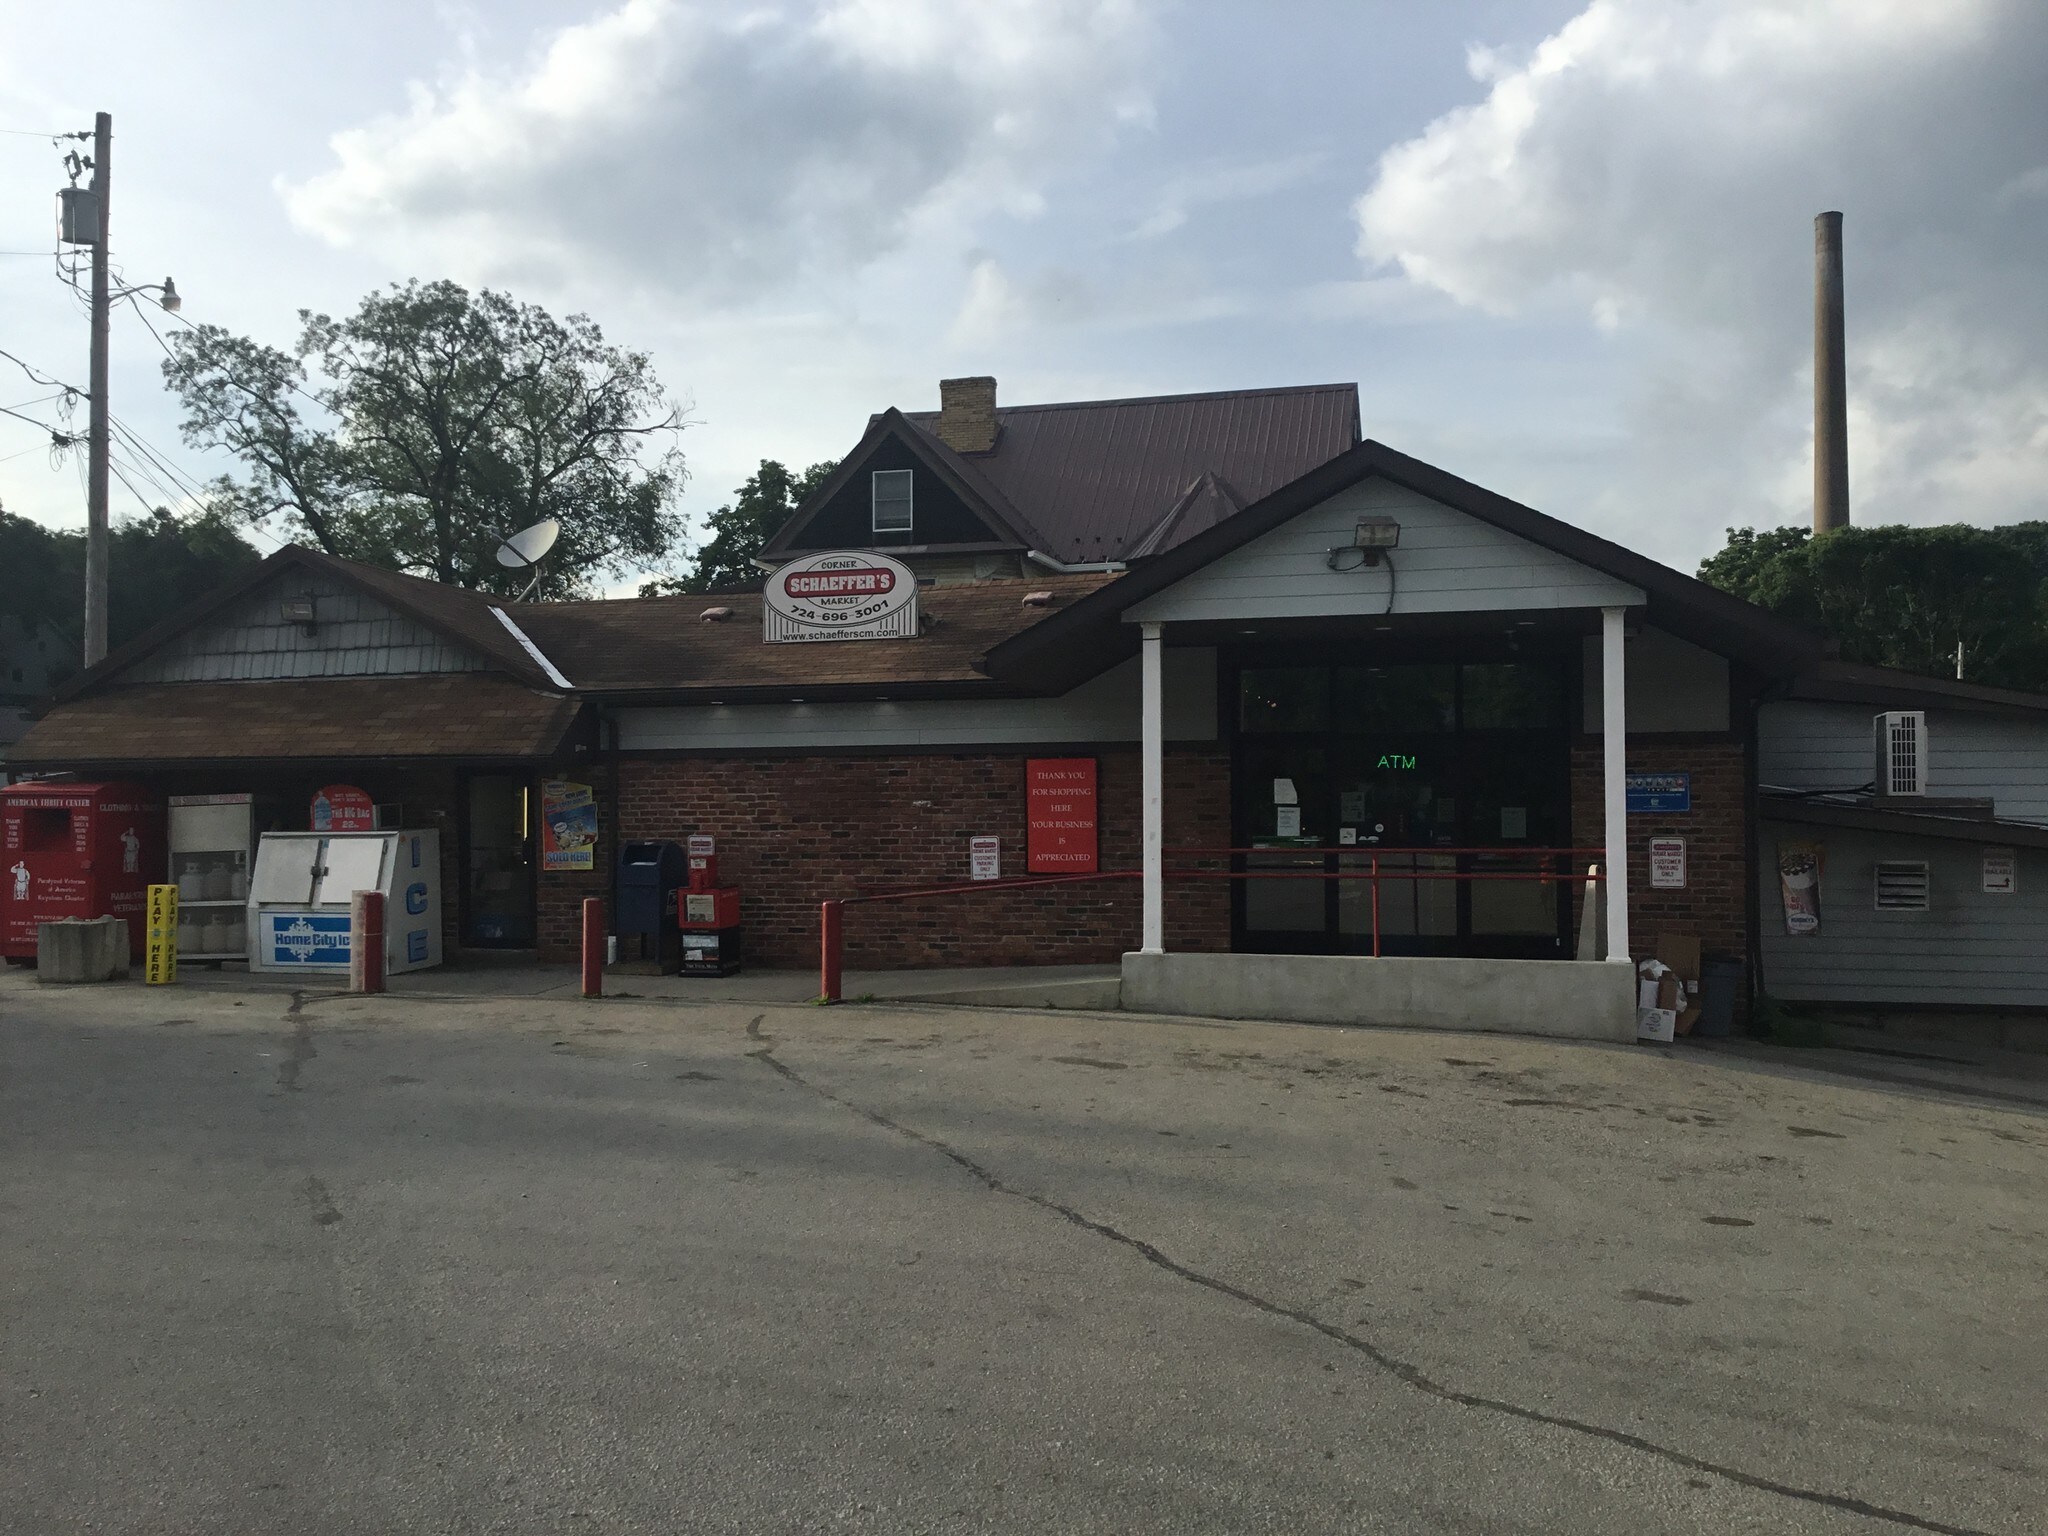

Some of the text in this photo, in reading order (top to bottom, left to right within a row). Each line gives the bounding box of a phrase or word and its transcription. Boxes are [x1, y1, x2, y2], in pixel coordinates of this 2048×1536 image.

[821, 560, 858, 570] CORNER
[790, 573, 891, 592] SCHAEFFER'S
[820, 596, 861, 606] MARKET
[790, 599, 890, 622] 724-696-3001
[782, 629, 899, 641] www.schaefferscm.com
[1377, 755, 1416, 769] ATM
[1038, 771, 1086, 780] THANK YOU
[1032, 788, 1092, 796] FOR SHOPPING
[6, 798, 91, 807] AMERICAN THRIFT CENTER
[1050, 804, 1073, 812] HERE
[1031, 820, 1094, 829] YOUR BUSINESS
[1058, 836, 1067, 845] IS
[547, 851, 569, 863] SOLD
[1035, 853, 1091, 862] APPRECIATED
[406, 836, 429, 964] ICE
[151, 887, 162, 982] PLAY HERE
[275, 933, 350, 949] Home City Ic
